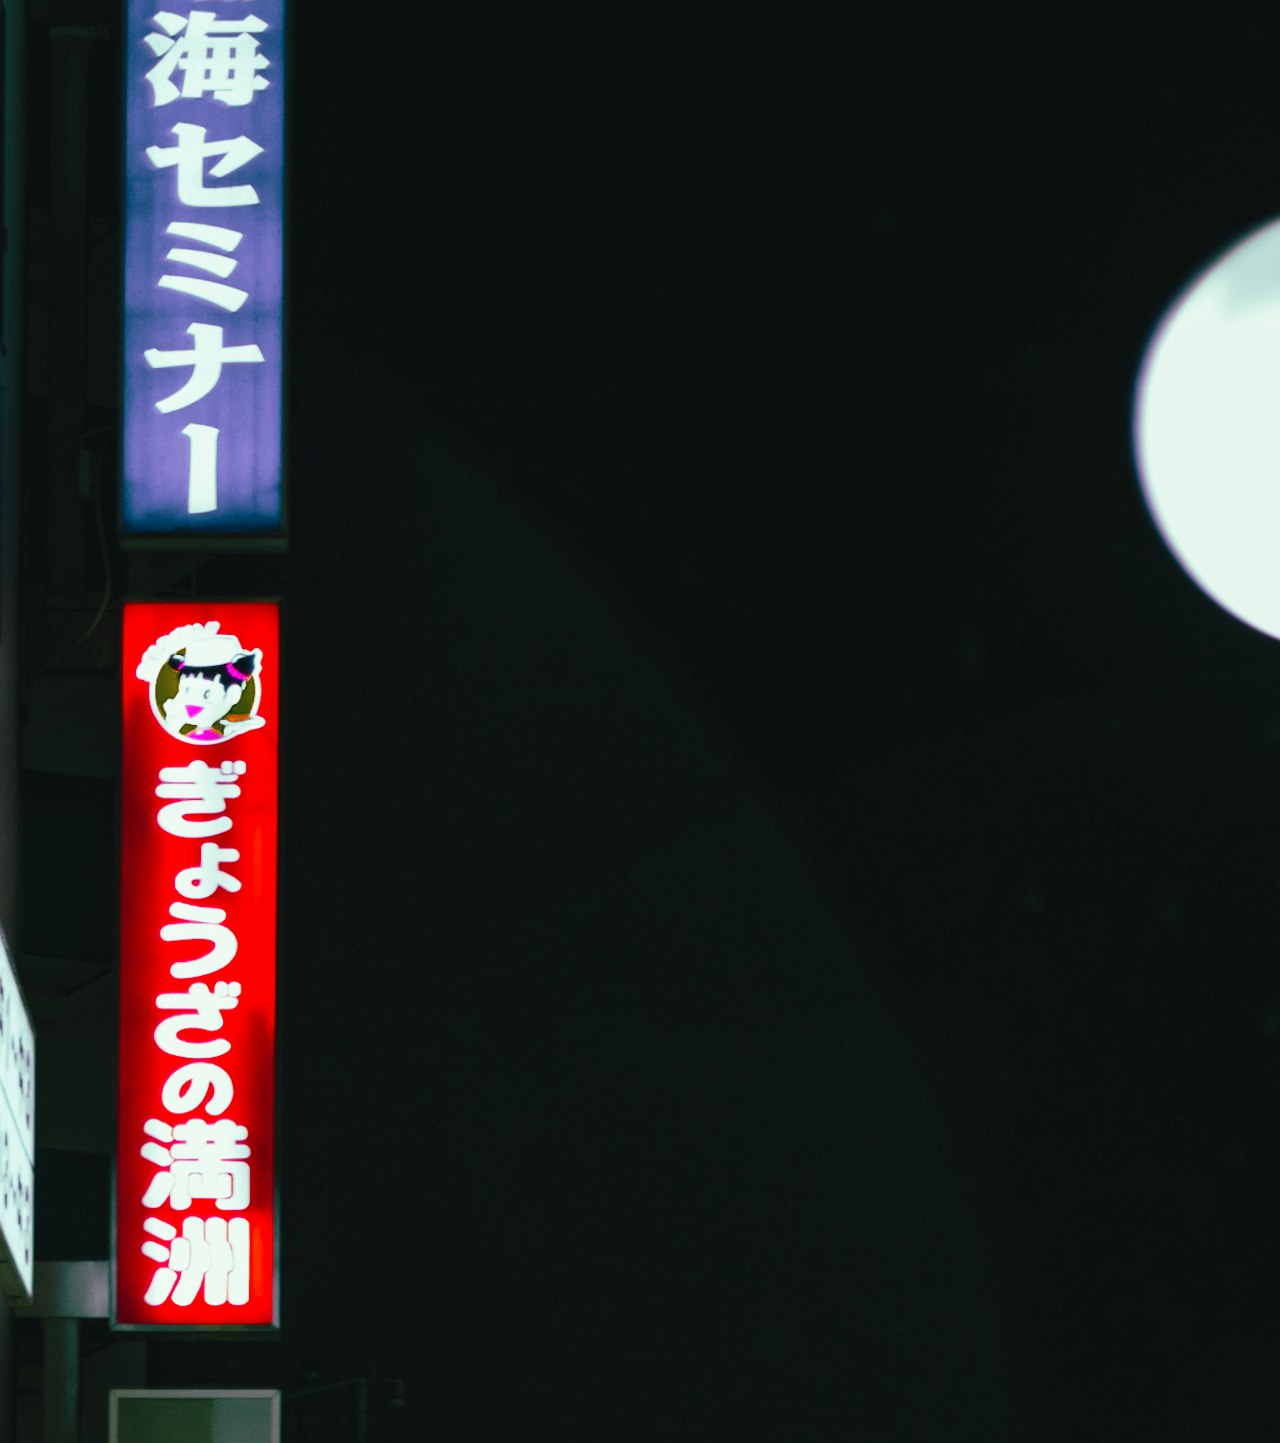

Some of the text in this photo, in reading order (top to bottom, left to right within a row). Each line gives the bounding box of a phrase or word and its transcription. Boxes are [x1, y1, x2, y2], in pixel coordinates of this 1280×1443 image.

[140, 8, 272, 516] 海セミナー
[140, 758, 252, 1308] ぎょうざの満洲
